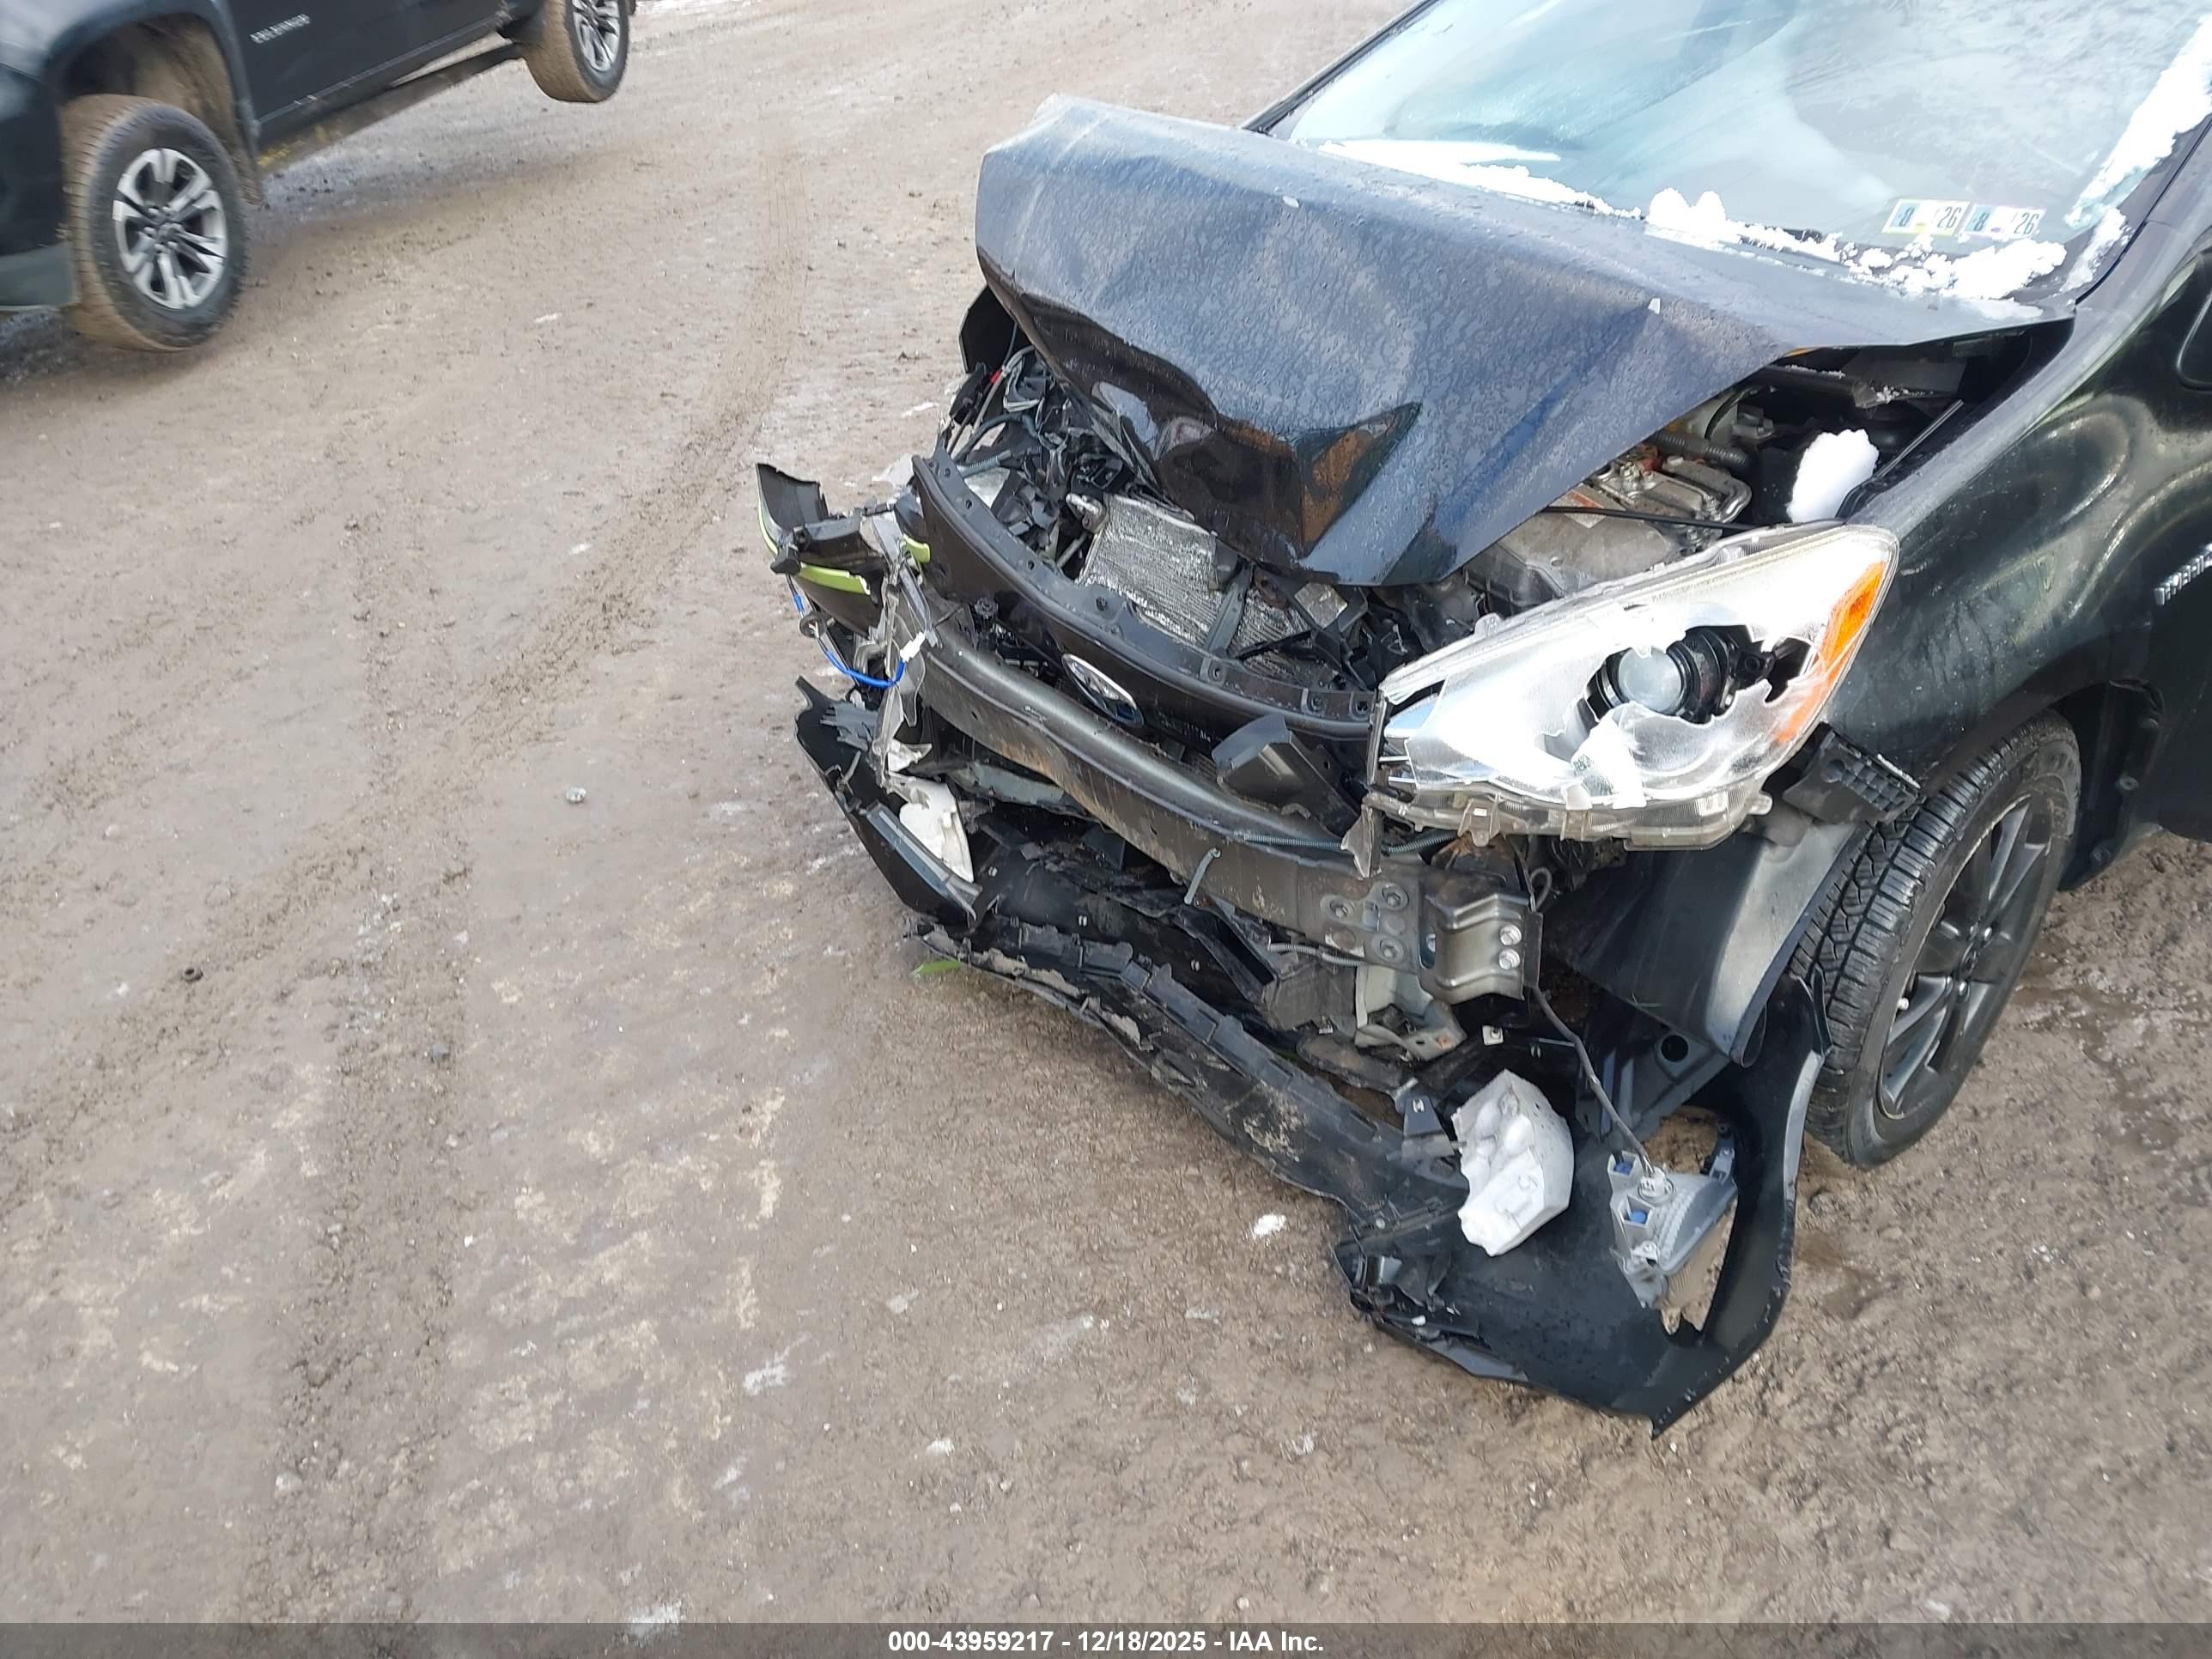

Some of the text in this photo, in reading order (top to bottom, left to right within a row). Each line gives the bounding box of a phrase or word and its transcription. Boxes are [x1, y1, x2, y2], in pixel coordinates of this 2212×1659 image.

[1899, 206, 1961, 228] 8 26
[1974, 212, 2039, 234] 8 26
